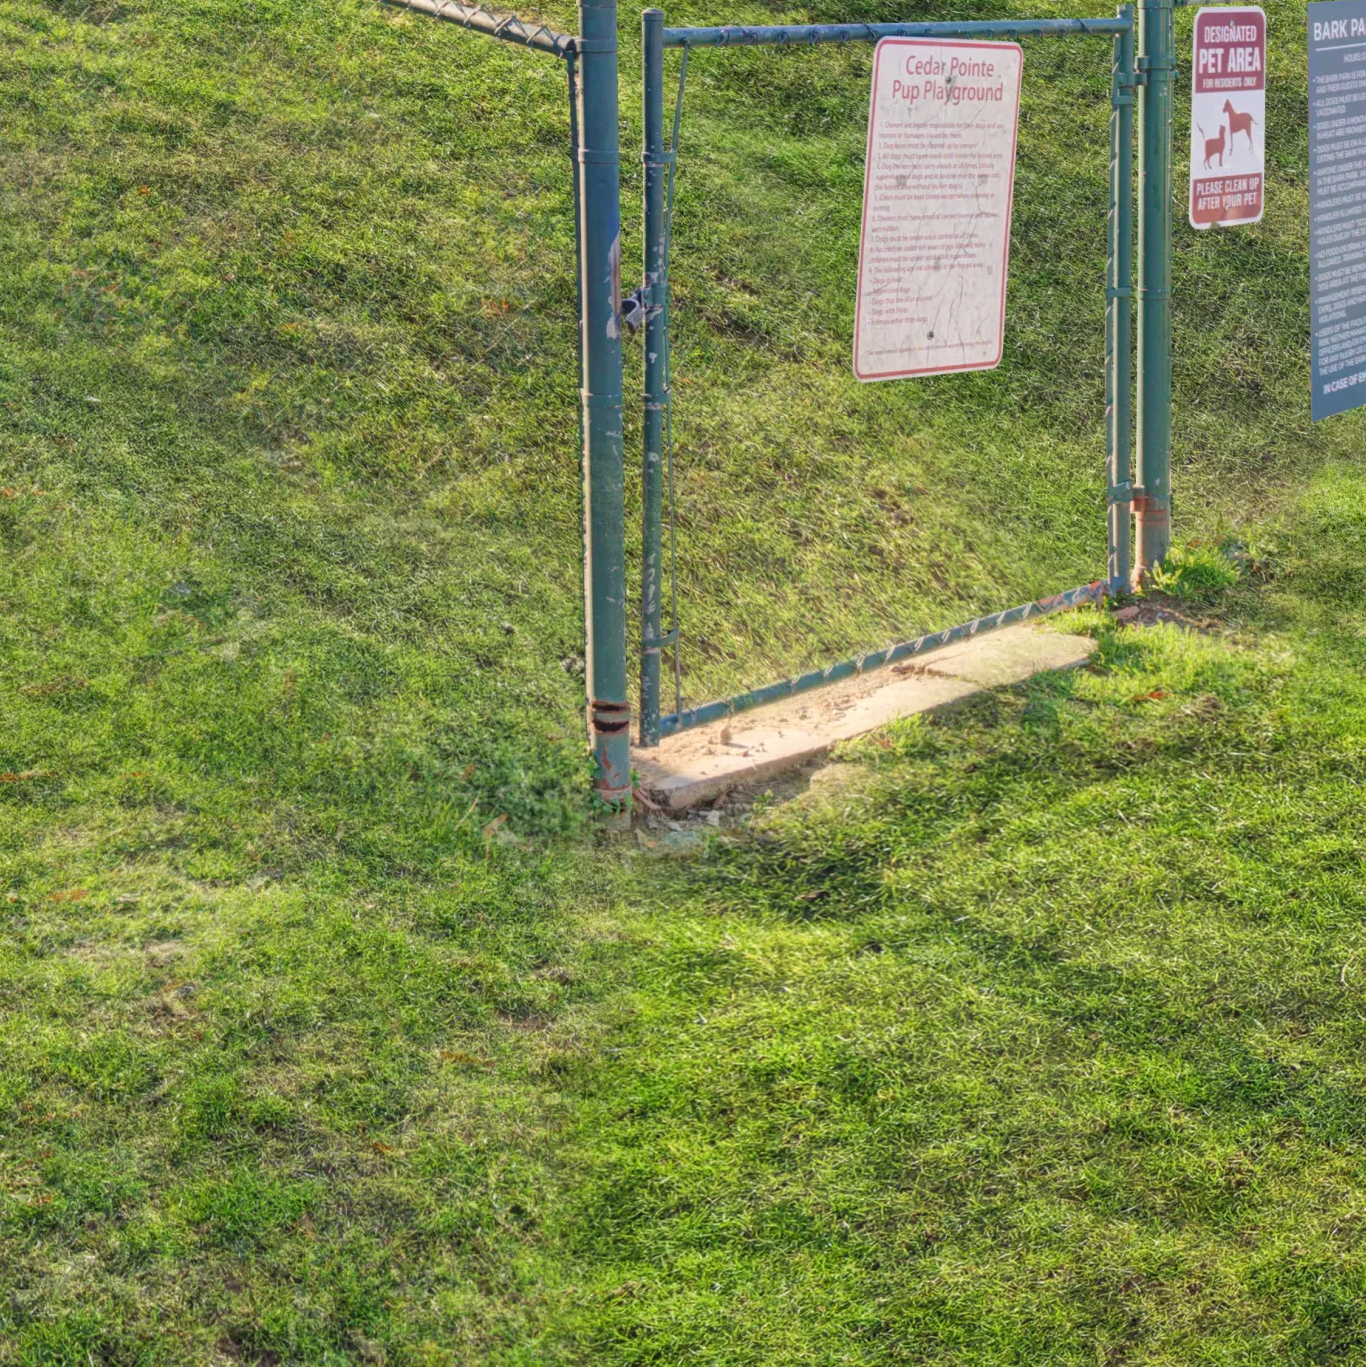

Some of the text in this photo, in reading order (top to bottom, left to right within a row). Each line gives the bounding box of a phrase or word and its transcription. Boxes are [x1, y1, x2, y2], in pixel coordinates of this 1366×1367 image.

[1204, 25, 1257, 44] DESIGNATED
[1313, 19, 1348, 42] BARK
[905, 55, 994, 78] Cedar Pointe
[1198, 47, 1262, 74] PET AREA
[1203, 76, 1257, 89] FOR RESIDENTS ONLY
[892, 80, 1004, 106] Pup Playground
[1196, 177, 1260, 196] PLEASE CLEAN UP
[1198, 192, 1257, 211] AFTER YOUR PET
[1331, 377, 1348, 392] CASE
[1349, 374, 1358, 387] OF
